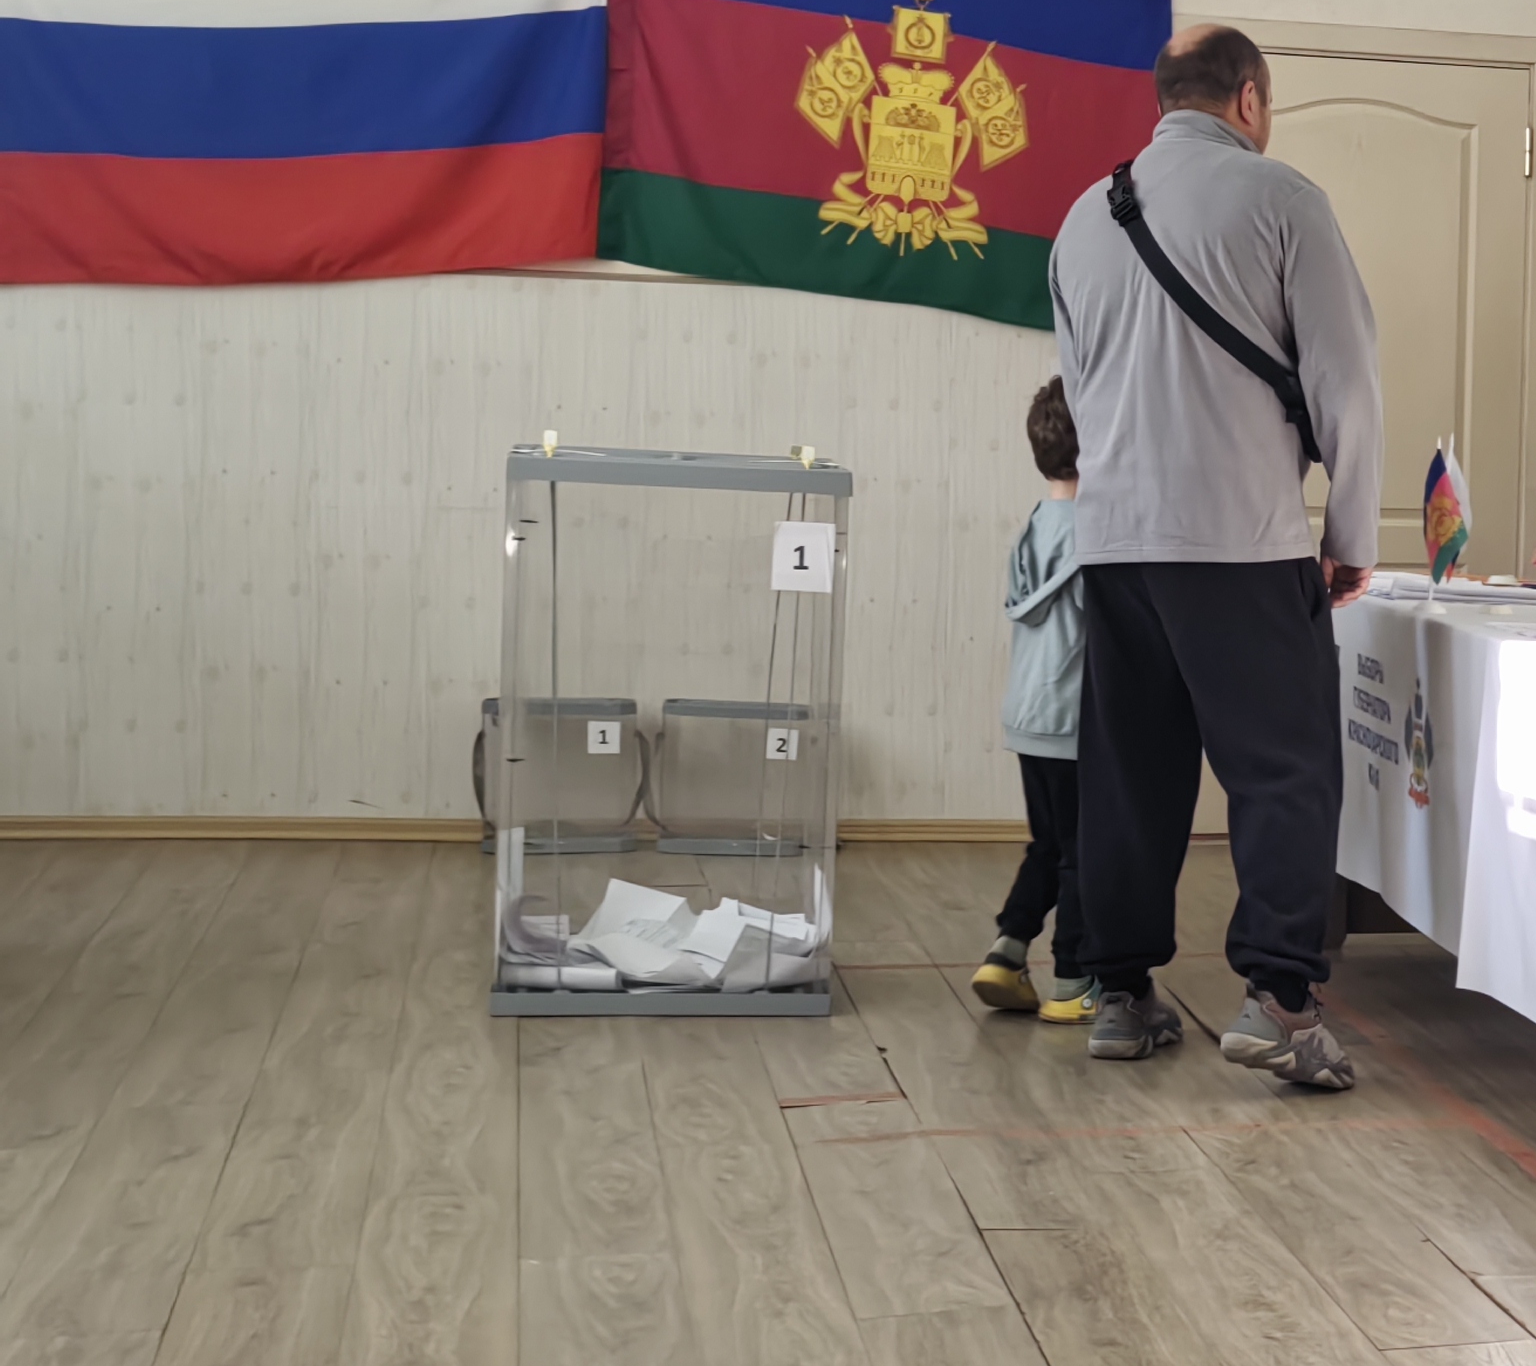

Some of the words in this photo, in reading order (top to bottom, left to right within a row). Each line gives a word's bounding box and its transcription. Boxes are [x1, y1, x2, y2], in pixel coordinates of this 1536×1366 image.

[793, 545, 810, 571] 1
[598, 729, 610, 745] 1
[775, 737, 788, 753] 2
